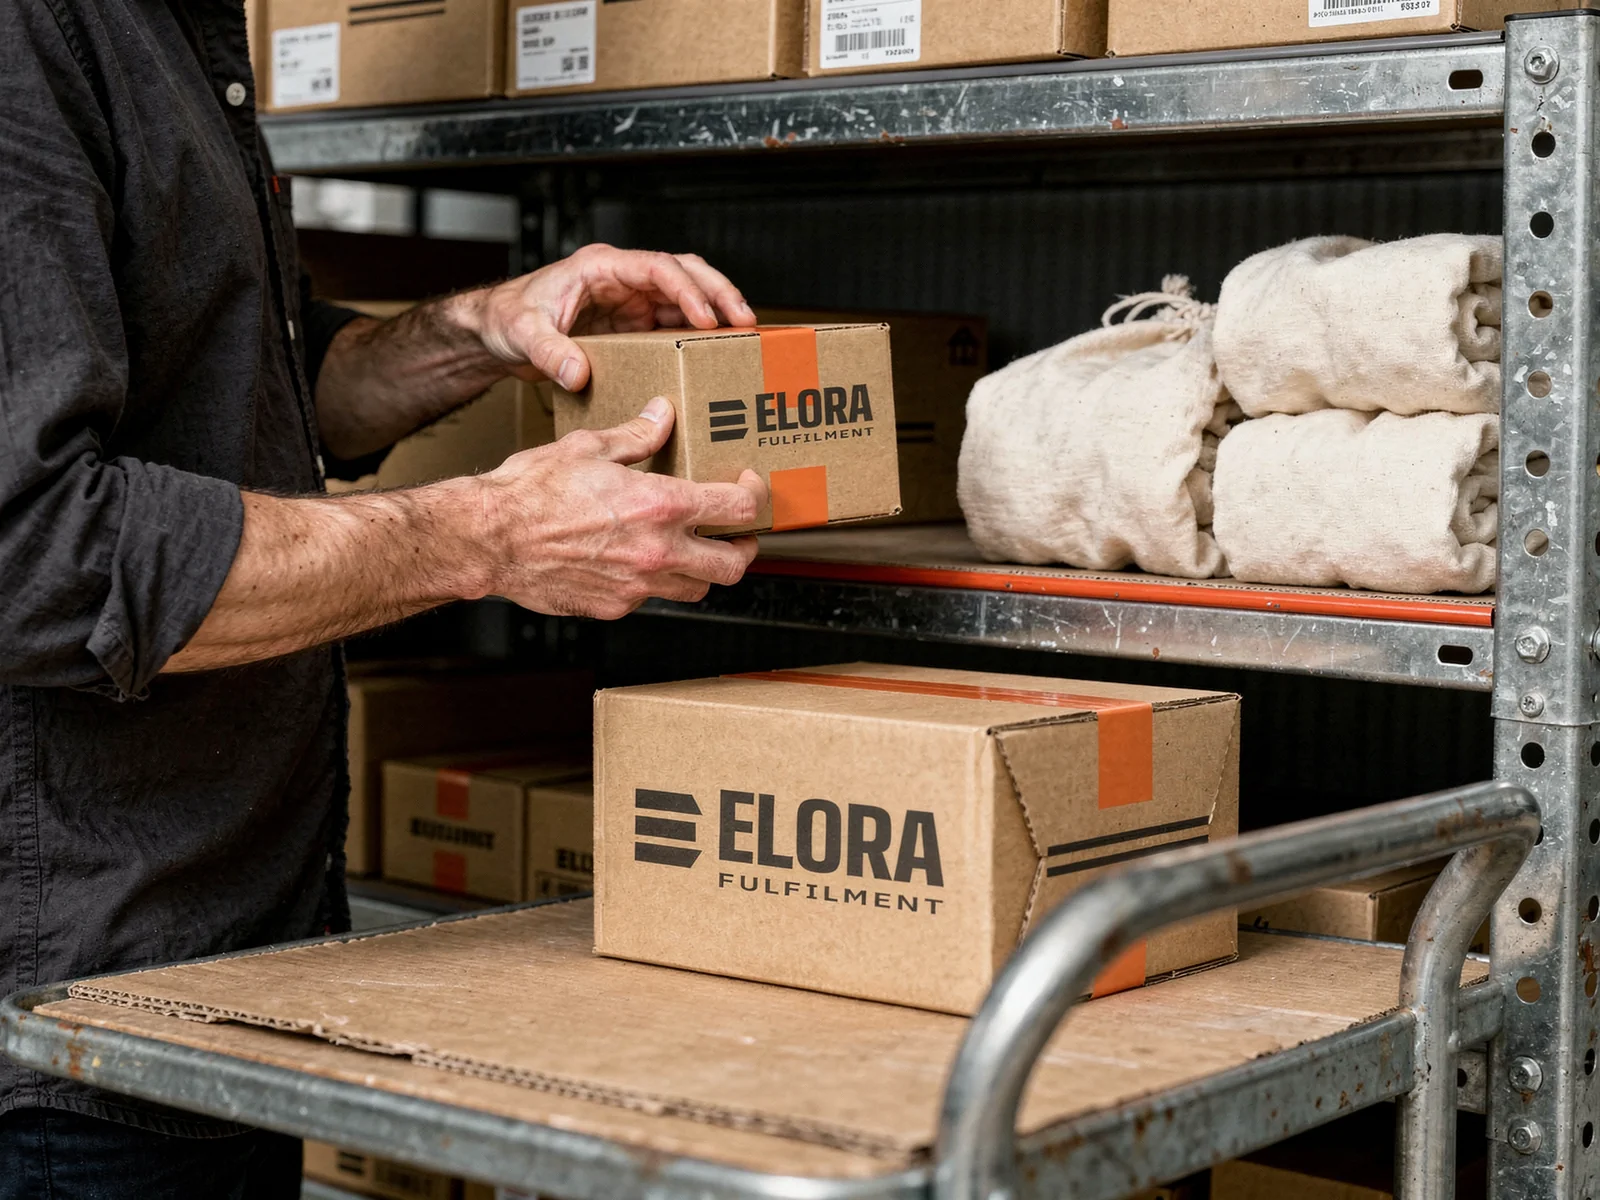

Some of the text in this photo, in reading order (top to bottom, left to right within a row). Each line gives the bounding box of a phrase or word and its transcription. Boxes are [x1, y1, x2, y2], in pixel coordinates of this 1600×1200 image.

[755, 384, 874, 432] ELORA
[758, 427, 874, 447] FULFILMENT
[719, 789, 944, 887] ELORA
[718, 872, 944, 915] FULFILMENT
